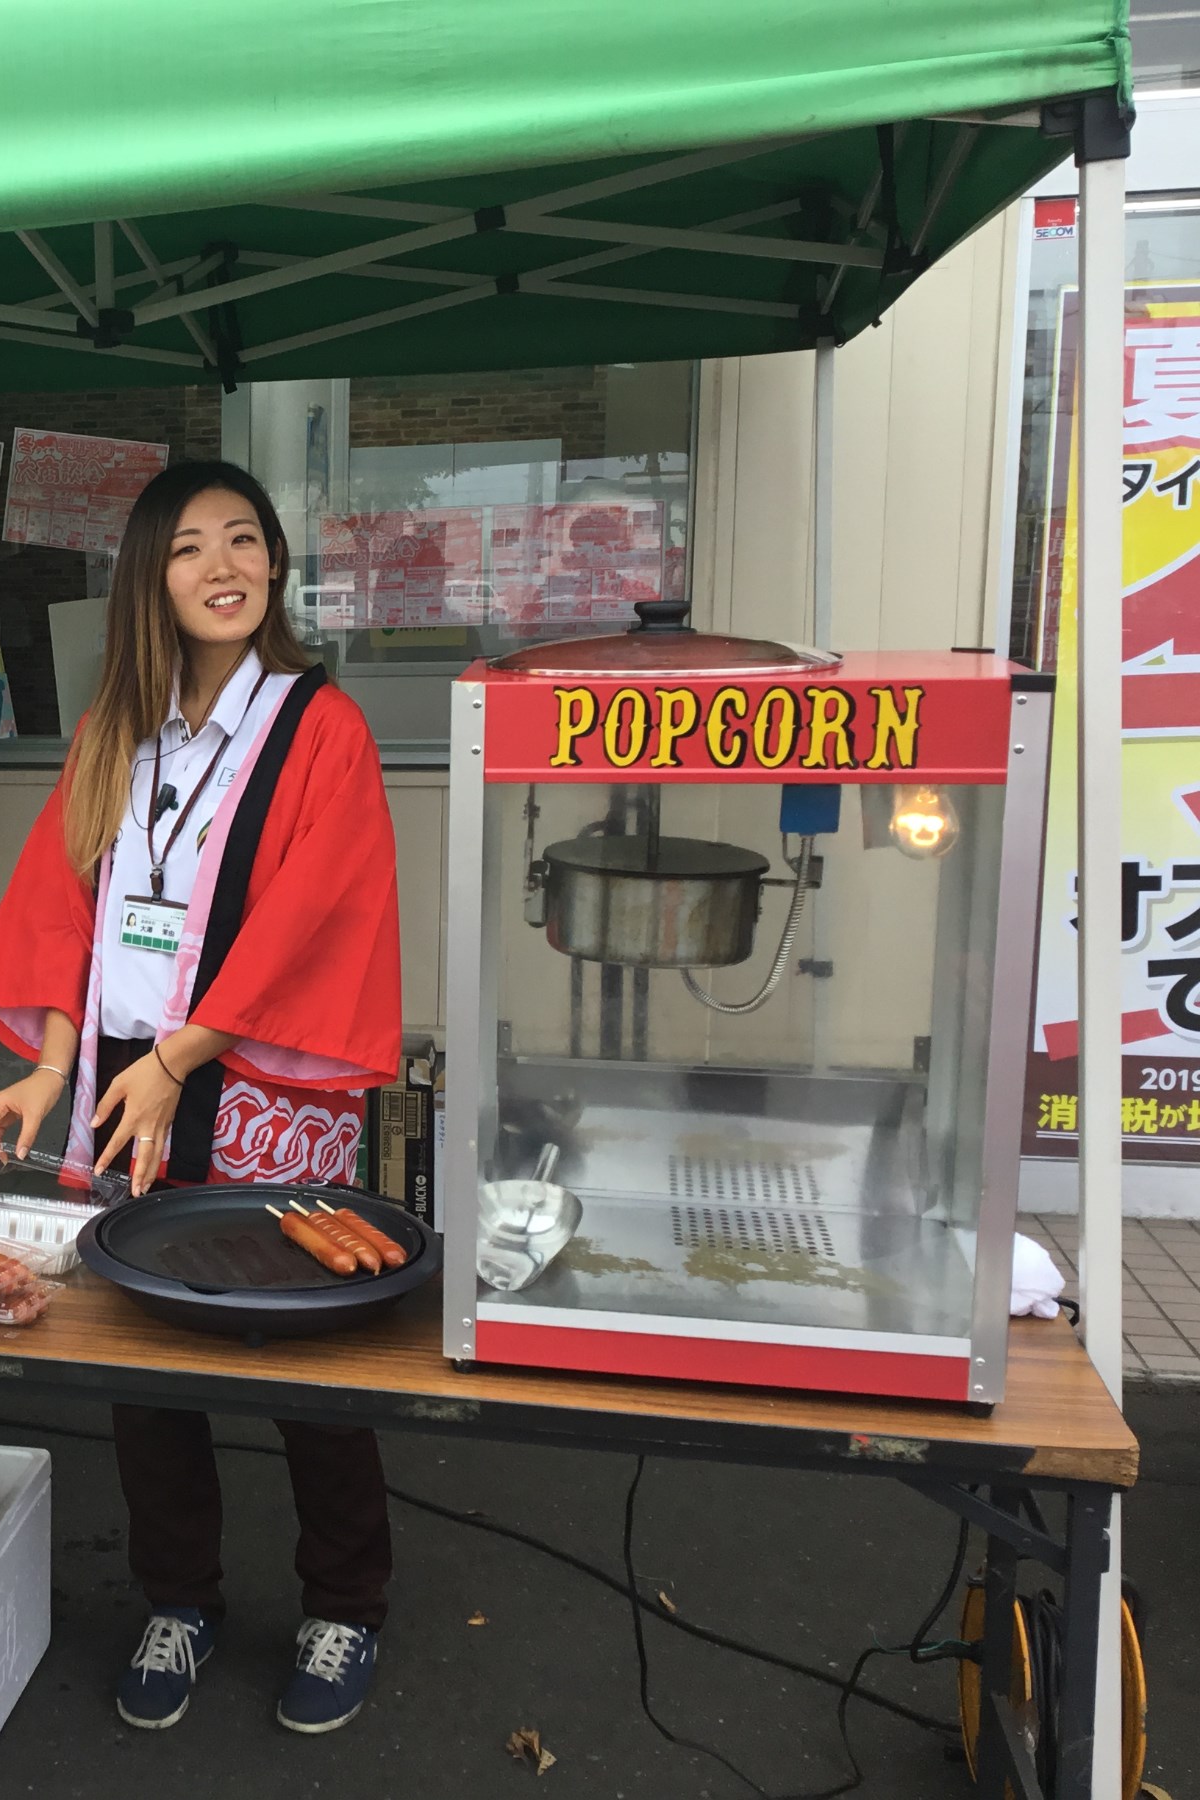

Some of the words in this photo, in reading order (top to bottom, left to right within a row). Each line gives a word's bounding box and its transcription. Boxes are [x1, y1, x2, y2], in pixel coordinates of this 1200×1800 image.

[1035, 226, 1073, 238] SECOM
[550, 685, 925, 770] POPCORN
[415, 1185, 427, 1212] BLACK
